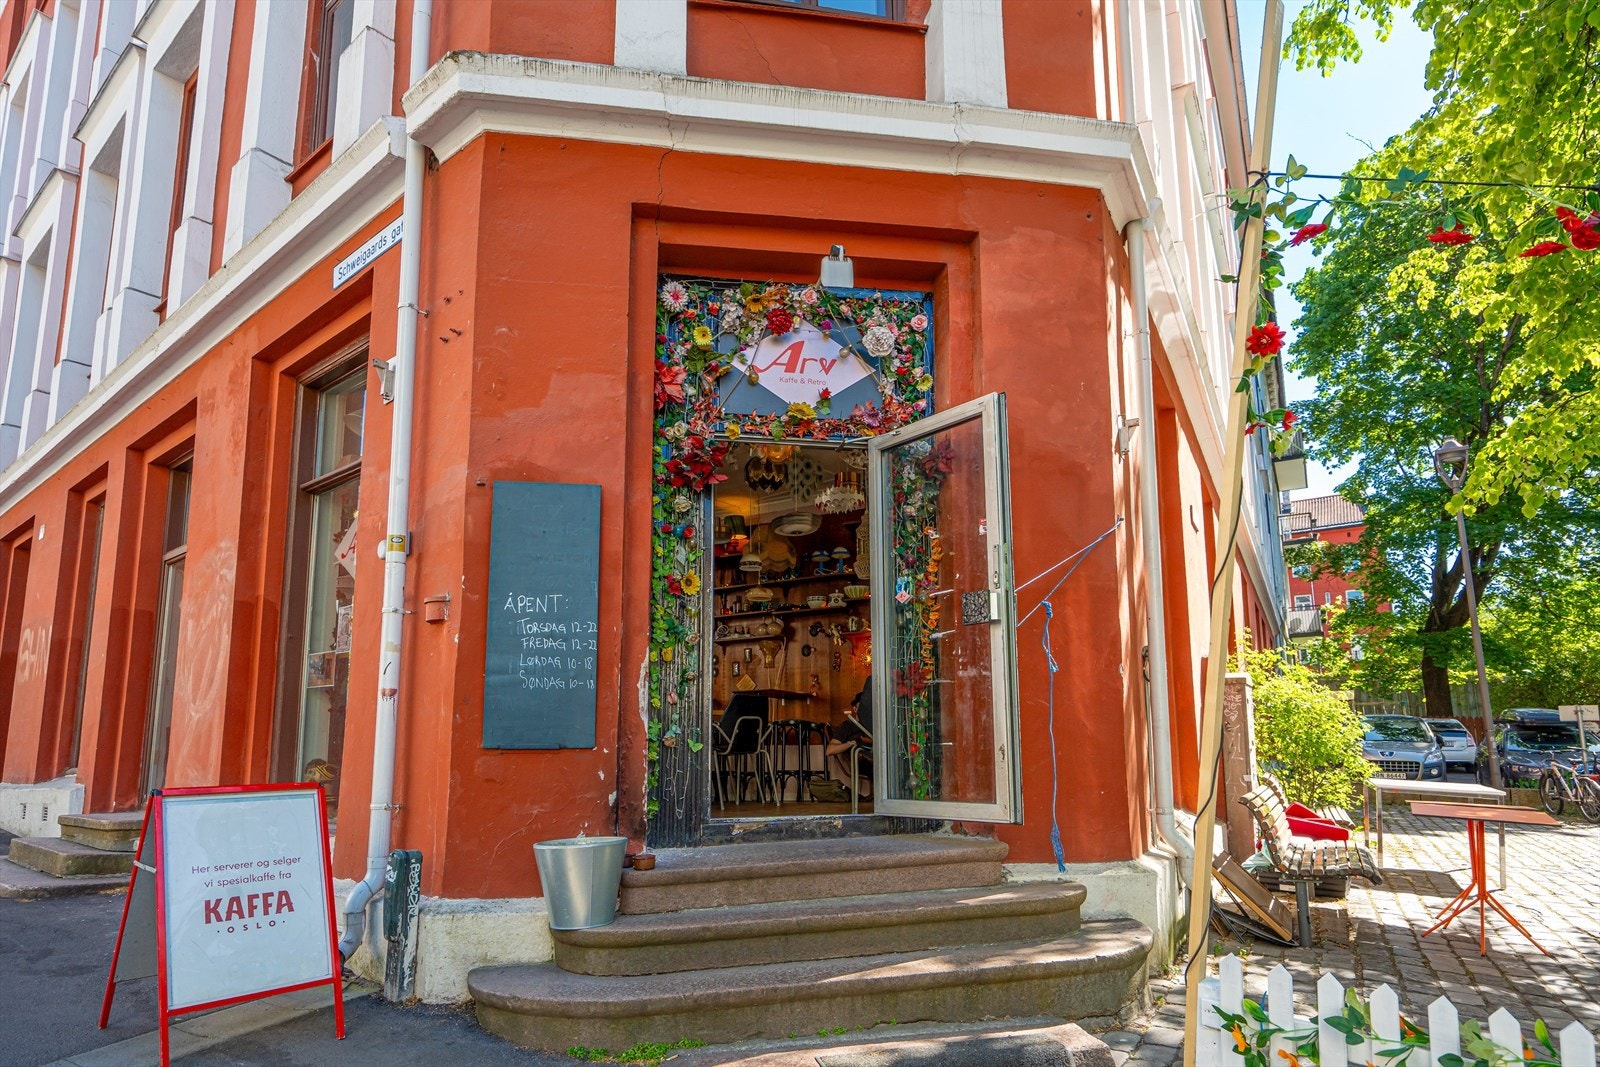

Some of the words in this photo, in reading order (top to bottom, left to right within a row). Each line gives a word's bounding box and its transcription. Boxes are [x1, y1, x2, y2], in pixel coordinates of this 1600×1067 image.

[338, 235, 387, 280] Schweigaards
[391, 220, 404, 243] gat
[752, 340, 837, 375] Arv
[779, 376, 798, 384] Kaffe
[807, 378, 827, 386] Retro
[517, 617, 566, 635] TORSDAG
[520, 636, 566, 651] FREDAG
[519, 653, 562, 669] LØRDAG
[519, 670, 565, 690] SØNDAG
[191, 865, 210, 874] Her
[214, 861, 254, 872] serverer
[256, 860, 270, 868] og
[273, 856, 301, 866] selger
[204, 879, 213, 888] vi
[217, 872, 276, 888] spesialkaffe
[279, 870, 292, 880] fra
[204, 890, 295, 925] KAFFA
